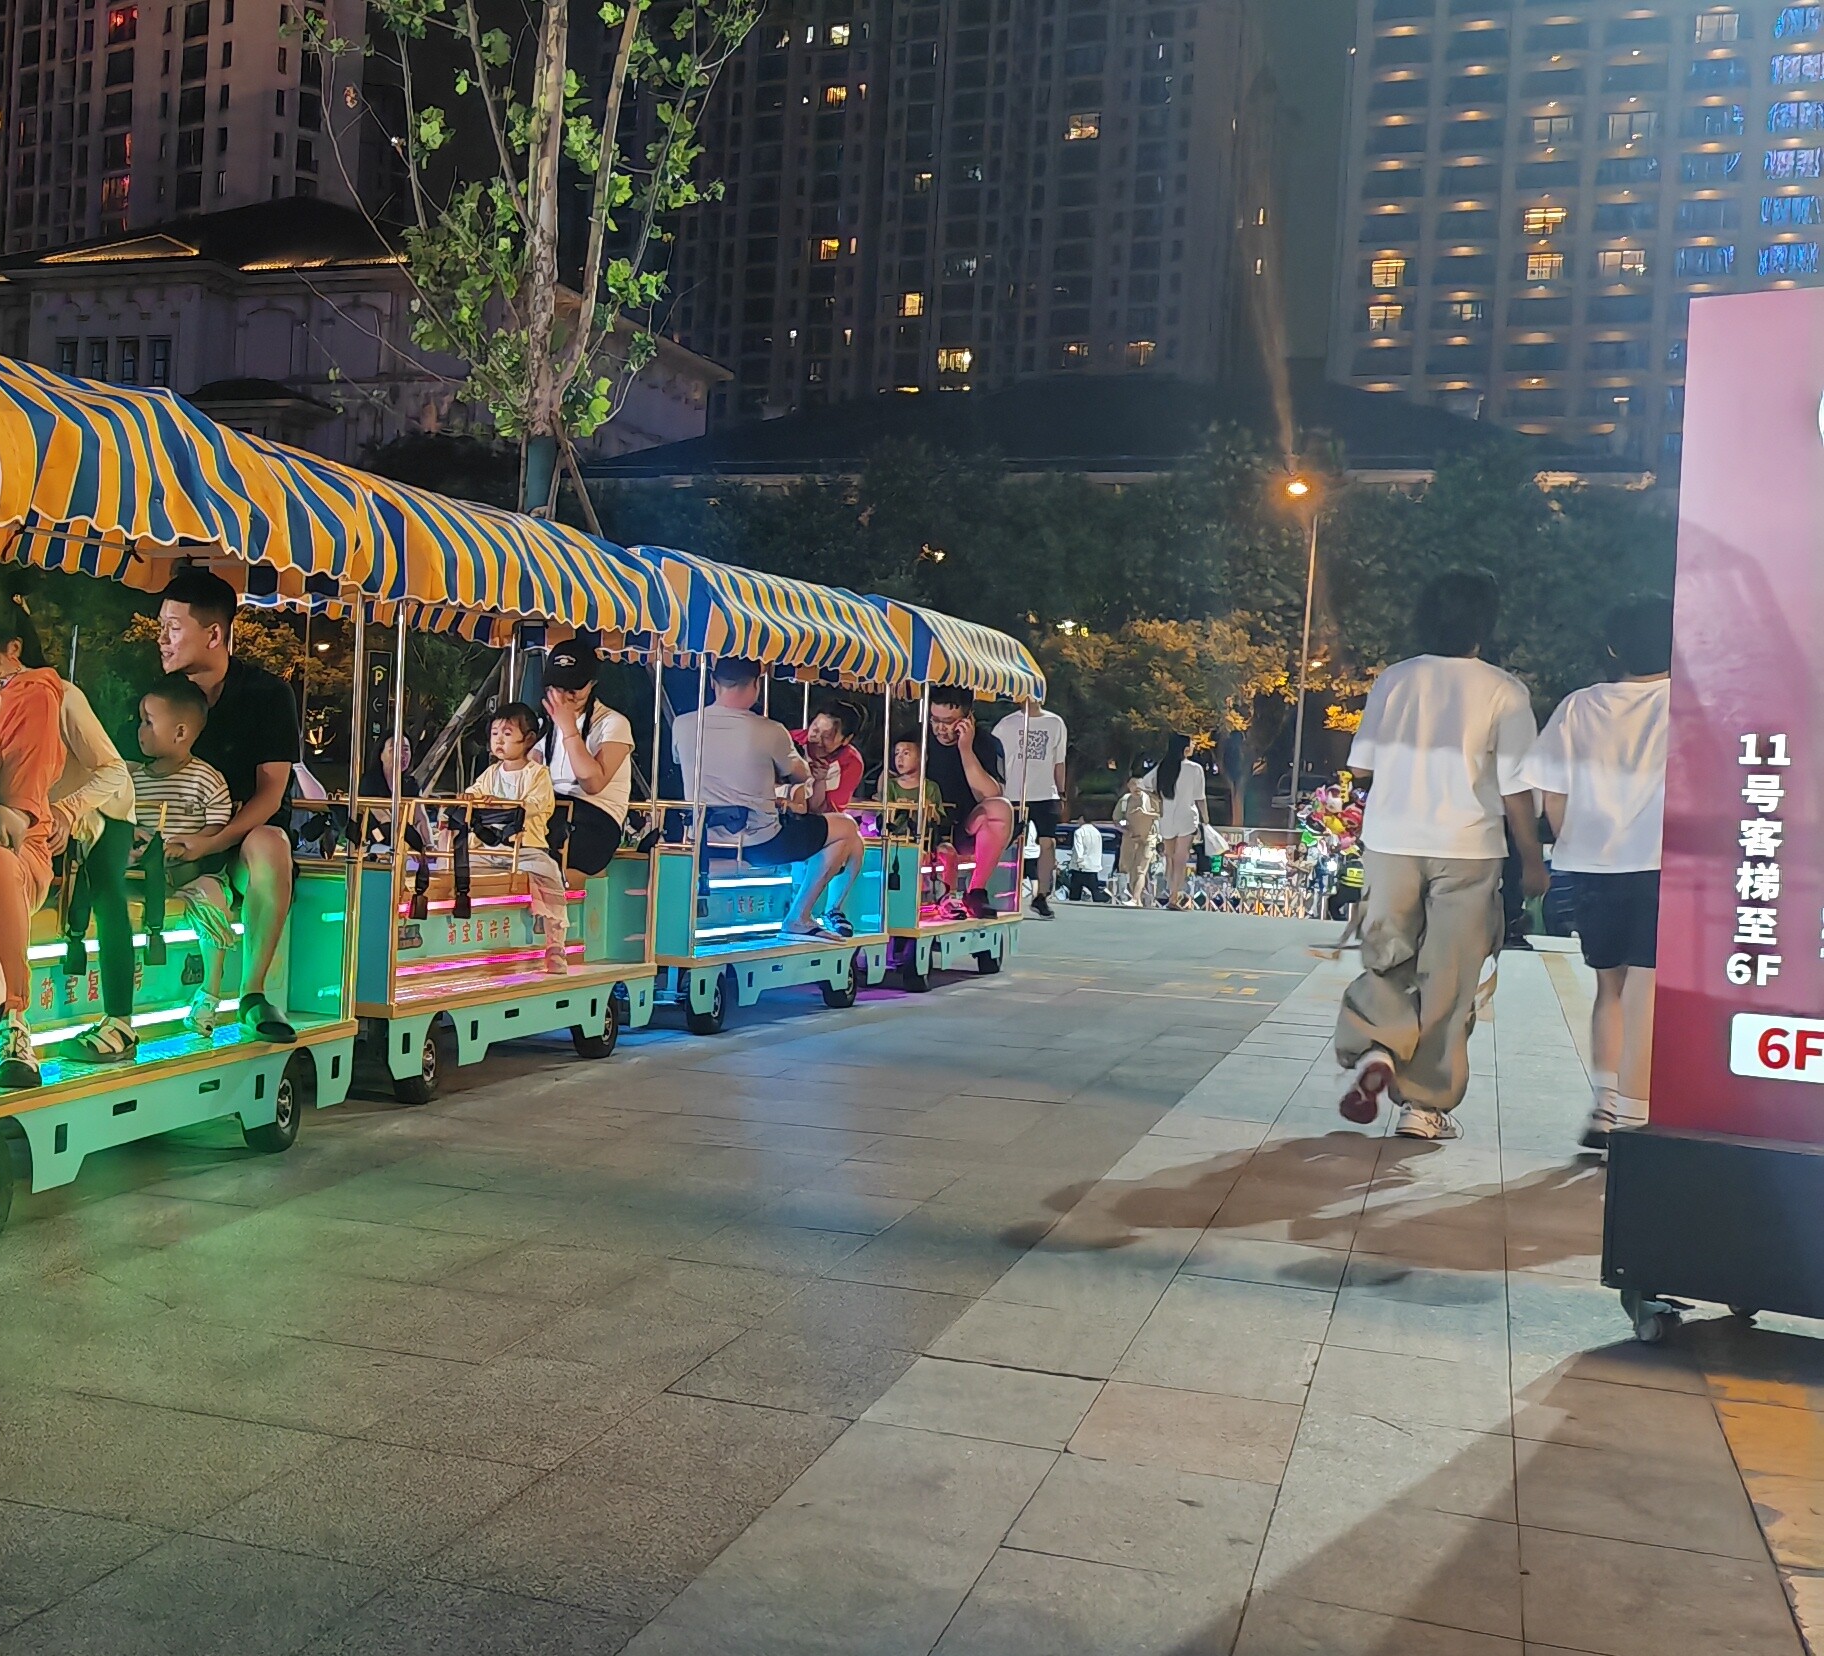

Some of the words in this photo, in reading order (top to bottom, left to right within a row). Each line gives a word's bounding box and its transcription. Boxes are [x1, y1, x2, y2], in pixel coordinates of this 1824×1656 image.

[1726, 732, 1791, 987] 11号客梯至6F
[40, 958, 144, 1010] 萌宝复号
[1758, 1027, 1824, 1071] 6F
